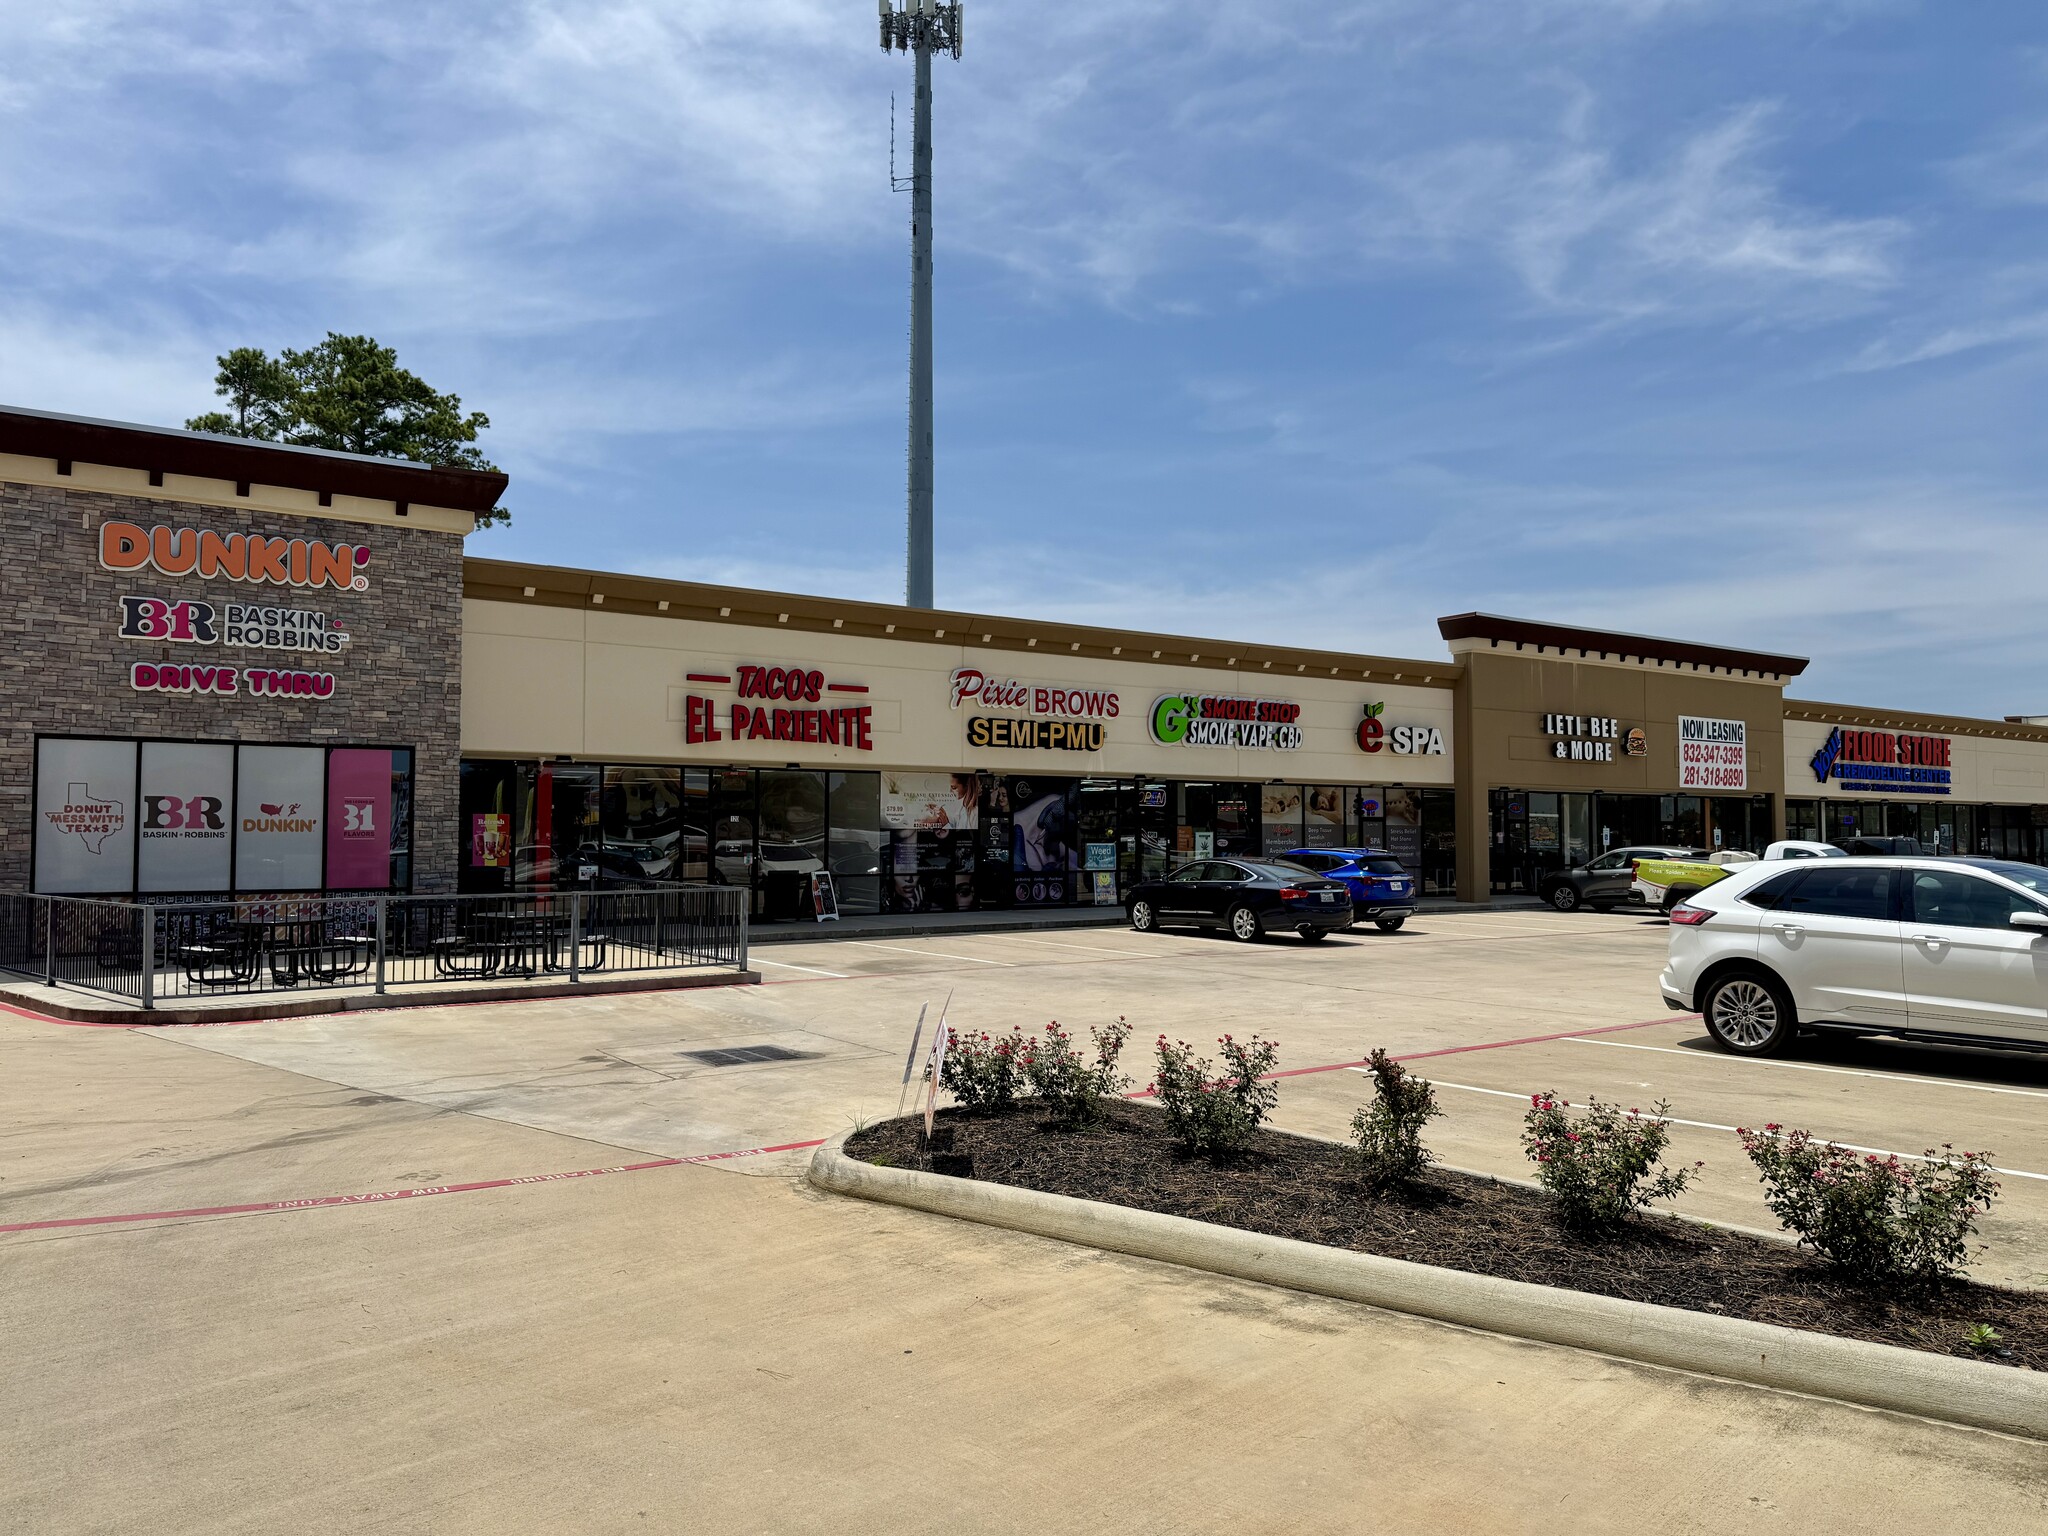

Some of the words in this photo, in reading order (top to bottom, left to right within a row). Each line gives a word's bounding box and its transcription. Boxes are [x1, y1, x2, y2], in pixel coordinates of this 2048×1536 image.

[101, 521, 371, 589] DUNKIN'
[121, 597, 217, 642] BR
[227, 606, 324, 631] BASKIN
[227, 625, 341, 651] ROBBINS
[134, 664, 237, 692] DRIVE
[247, 670, 334, 697] THRU
[736, 665, 825, 703] TACOS
[954, 669, 1028, 707] Pixie
[1034, 688, 1120, 718] BROWS
[686, 694, 722, 745] EL
[731, 703, 873, 751] PARIENTE
[1200, 698, 1257, 721] SMOKE
[1258, 702, 1301, 724] SHOP
[970, 717, 1105, 750] SEMI-PMU
[1187, 720, 1234, 745] SMOKE
[1239, 723, 1273, 748] VAPE
[1277, 726, 1304, 749] CBD
[1545, 713, 1582, 736] LETI
[1588, 716, 1618, 739] BEE
[1681, 718, 1704, 739] NOW
[1706, 719, 1744, 742] LEASING
[1390, 725, 1447, 755] SPA
[1554, 741, 1567, 759] &
[1569, 740, 1613, 762] MORE
[1841, 730, 1896, 763] FLOOR
[1898, 734, 1951, 767] STORE
[1683, 743, 1743, 765] 832-347-3399
[1683, 765, 1744, 787] 281-318-8890
[1832, 763, 1842, 778] &
[1842, 763, 1911, 782] REMODELING
[1911, 768, 1951, 783] CENTER
[49, 815, 85, 823] MESS
[89, 815, 125, 823] WITH
[63, 805, 112, 814] DONUT
[143, 795, 225, 830] BR
[343, 804, 375, 831] 31
[143, 831, 178, 839] BASKIN
[184, 831, 225, 839] ROBBINS
[242, 818, 317, 833] DUNKIN'
